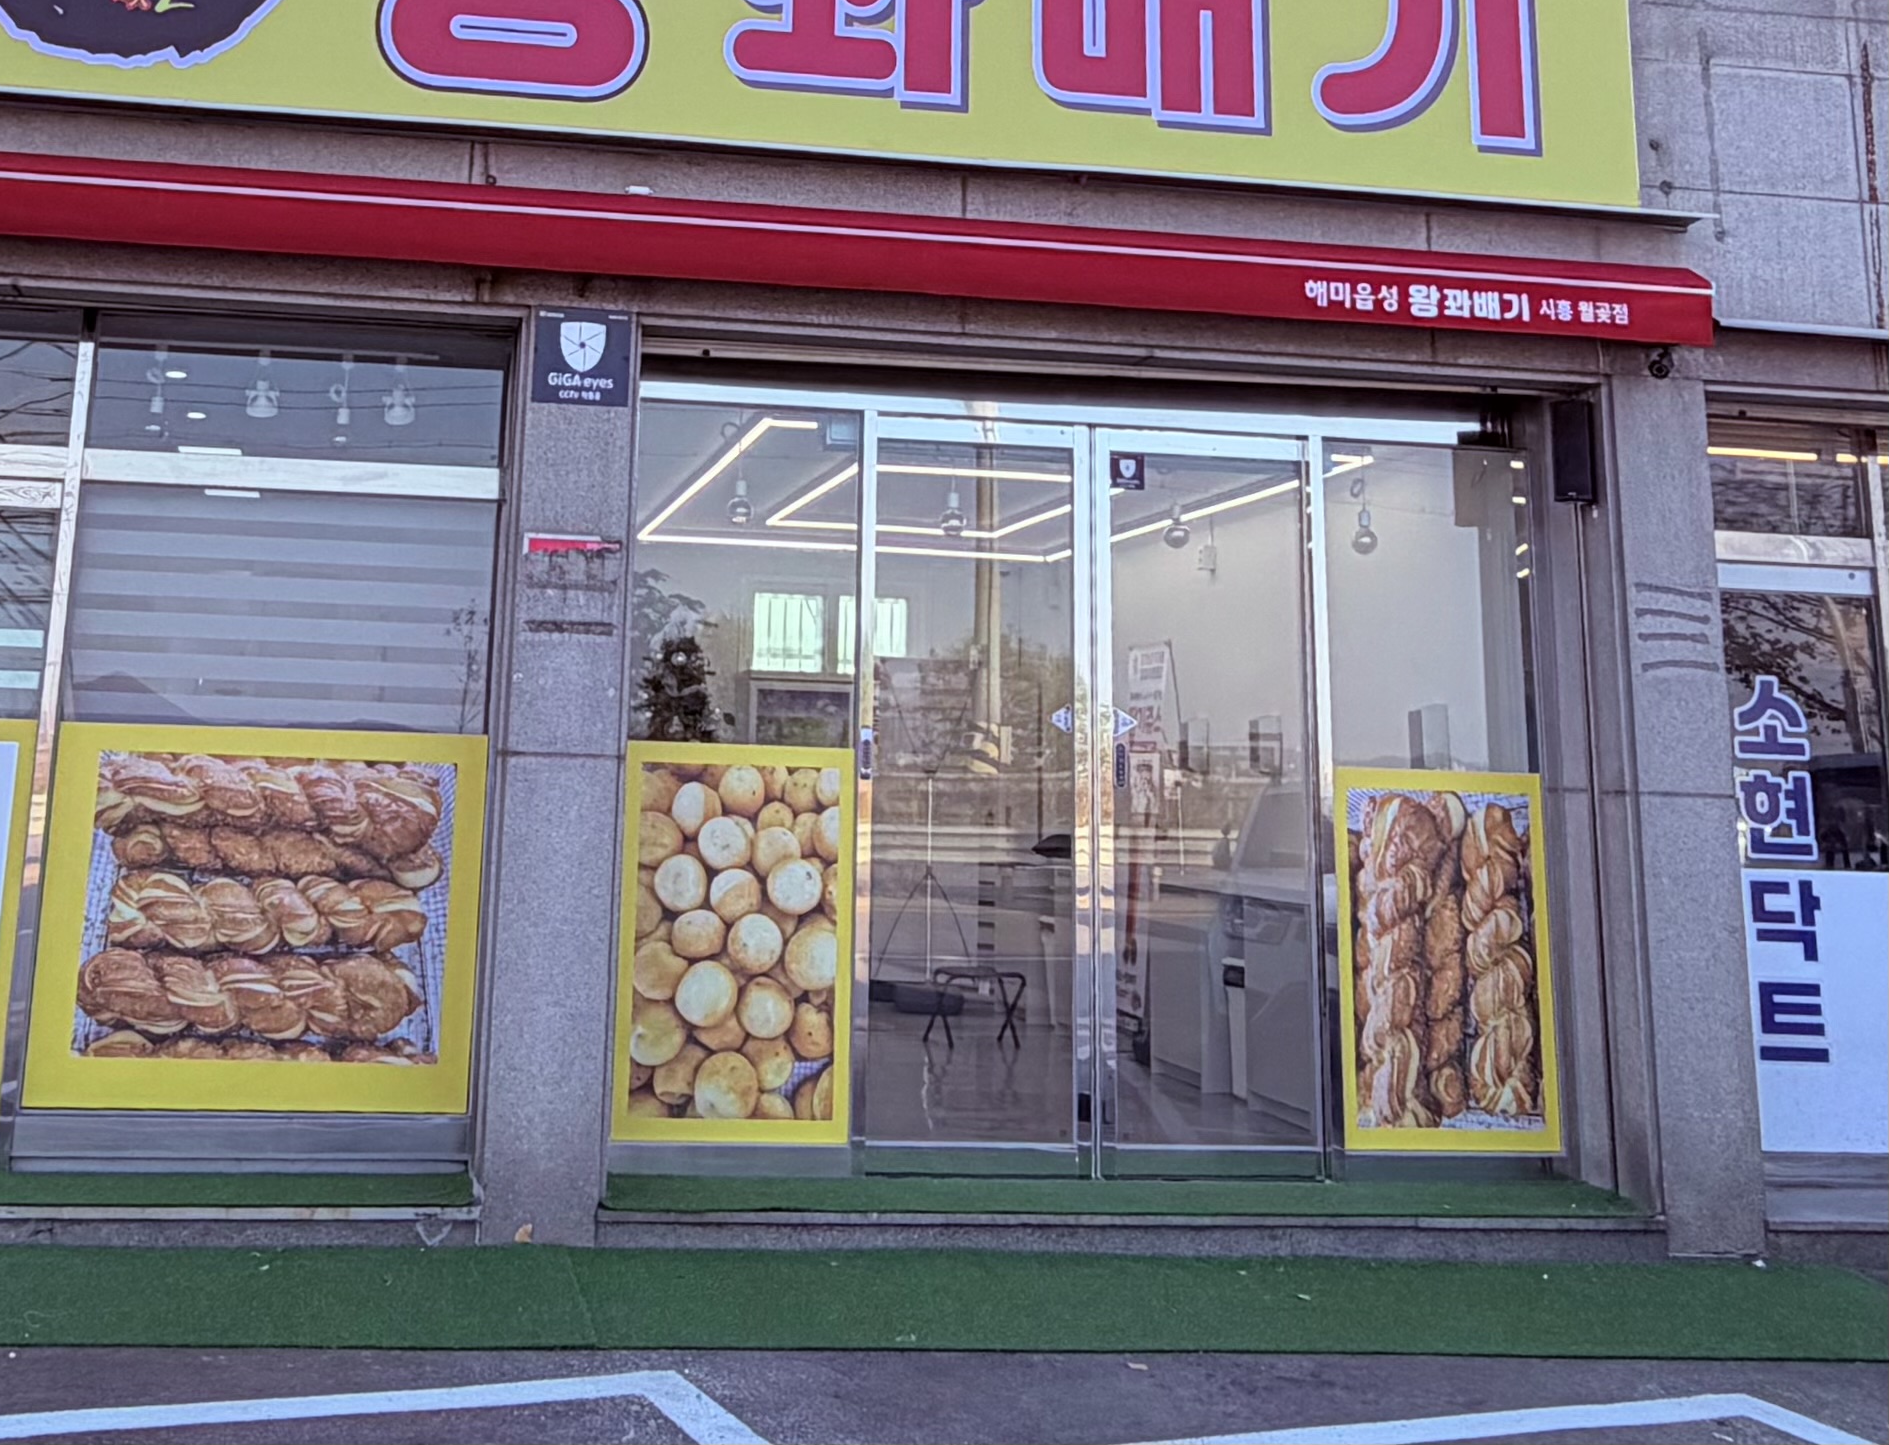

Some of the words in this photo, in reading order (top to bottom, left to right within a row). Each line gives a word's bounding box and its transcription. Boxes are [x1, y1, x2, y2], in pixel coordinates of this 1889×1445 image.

[1304, 278, 1399, 312] 해미읍성
[1408, 284, 1531, 322] 왕꽈배기
[1539, 298, 1574, 322] 시흥
[583, 377, 614, 390] eyes
